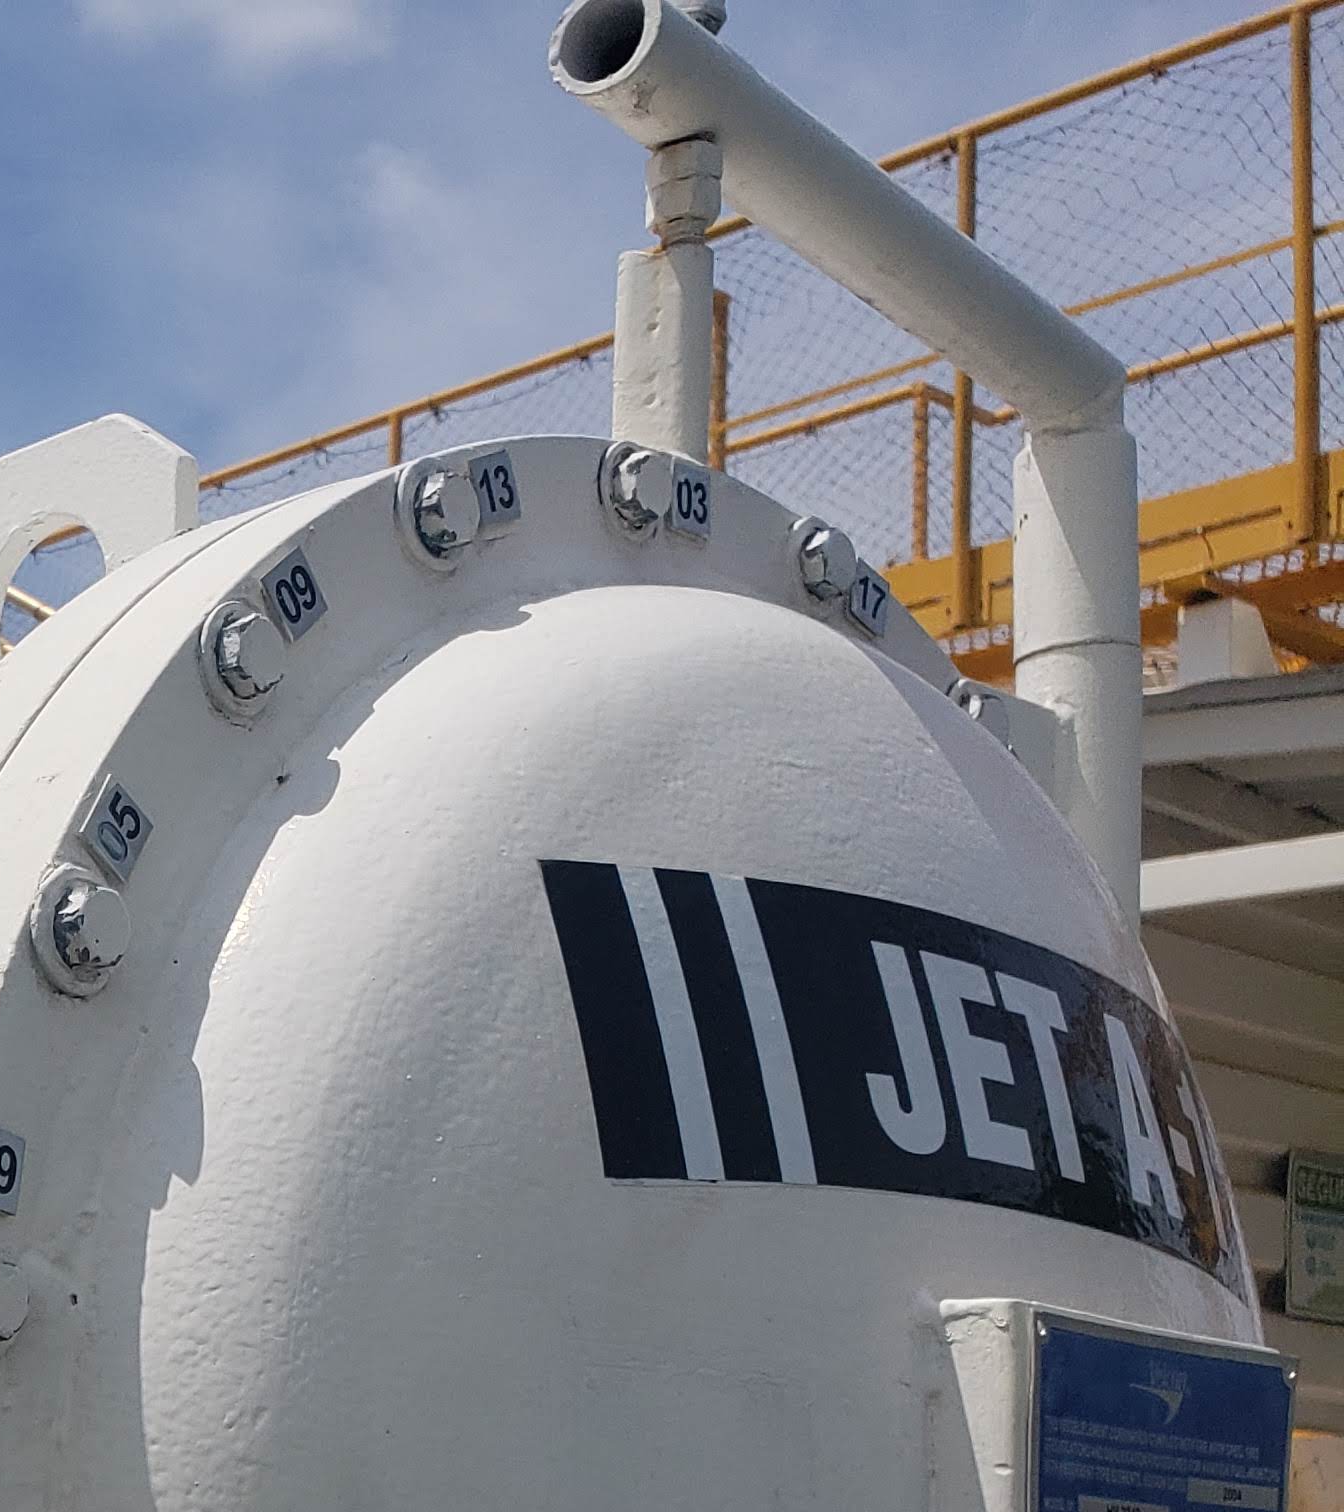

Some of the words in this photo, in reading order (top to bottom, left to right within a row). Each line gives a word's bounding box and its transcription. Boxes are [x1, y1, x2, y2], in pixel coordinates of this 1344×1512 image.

[480, 465, 513, 511] 13
[676, 479, 708, 524] 03
[275, 564, 316, 625] 09
[857, 576, 886, 615] 17
[97, 791, 141, 862] 05
[864, 939, 1085, 1184] JET
